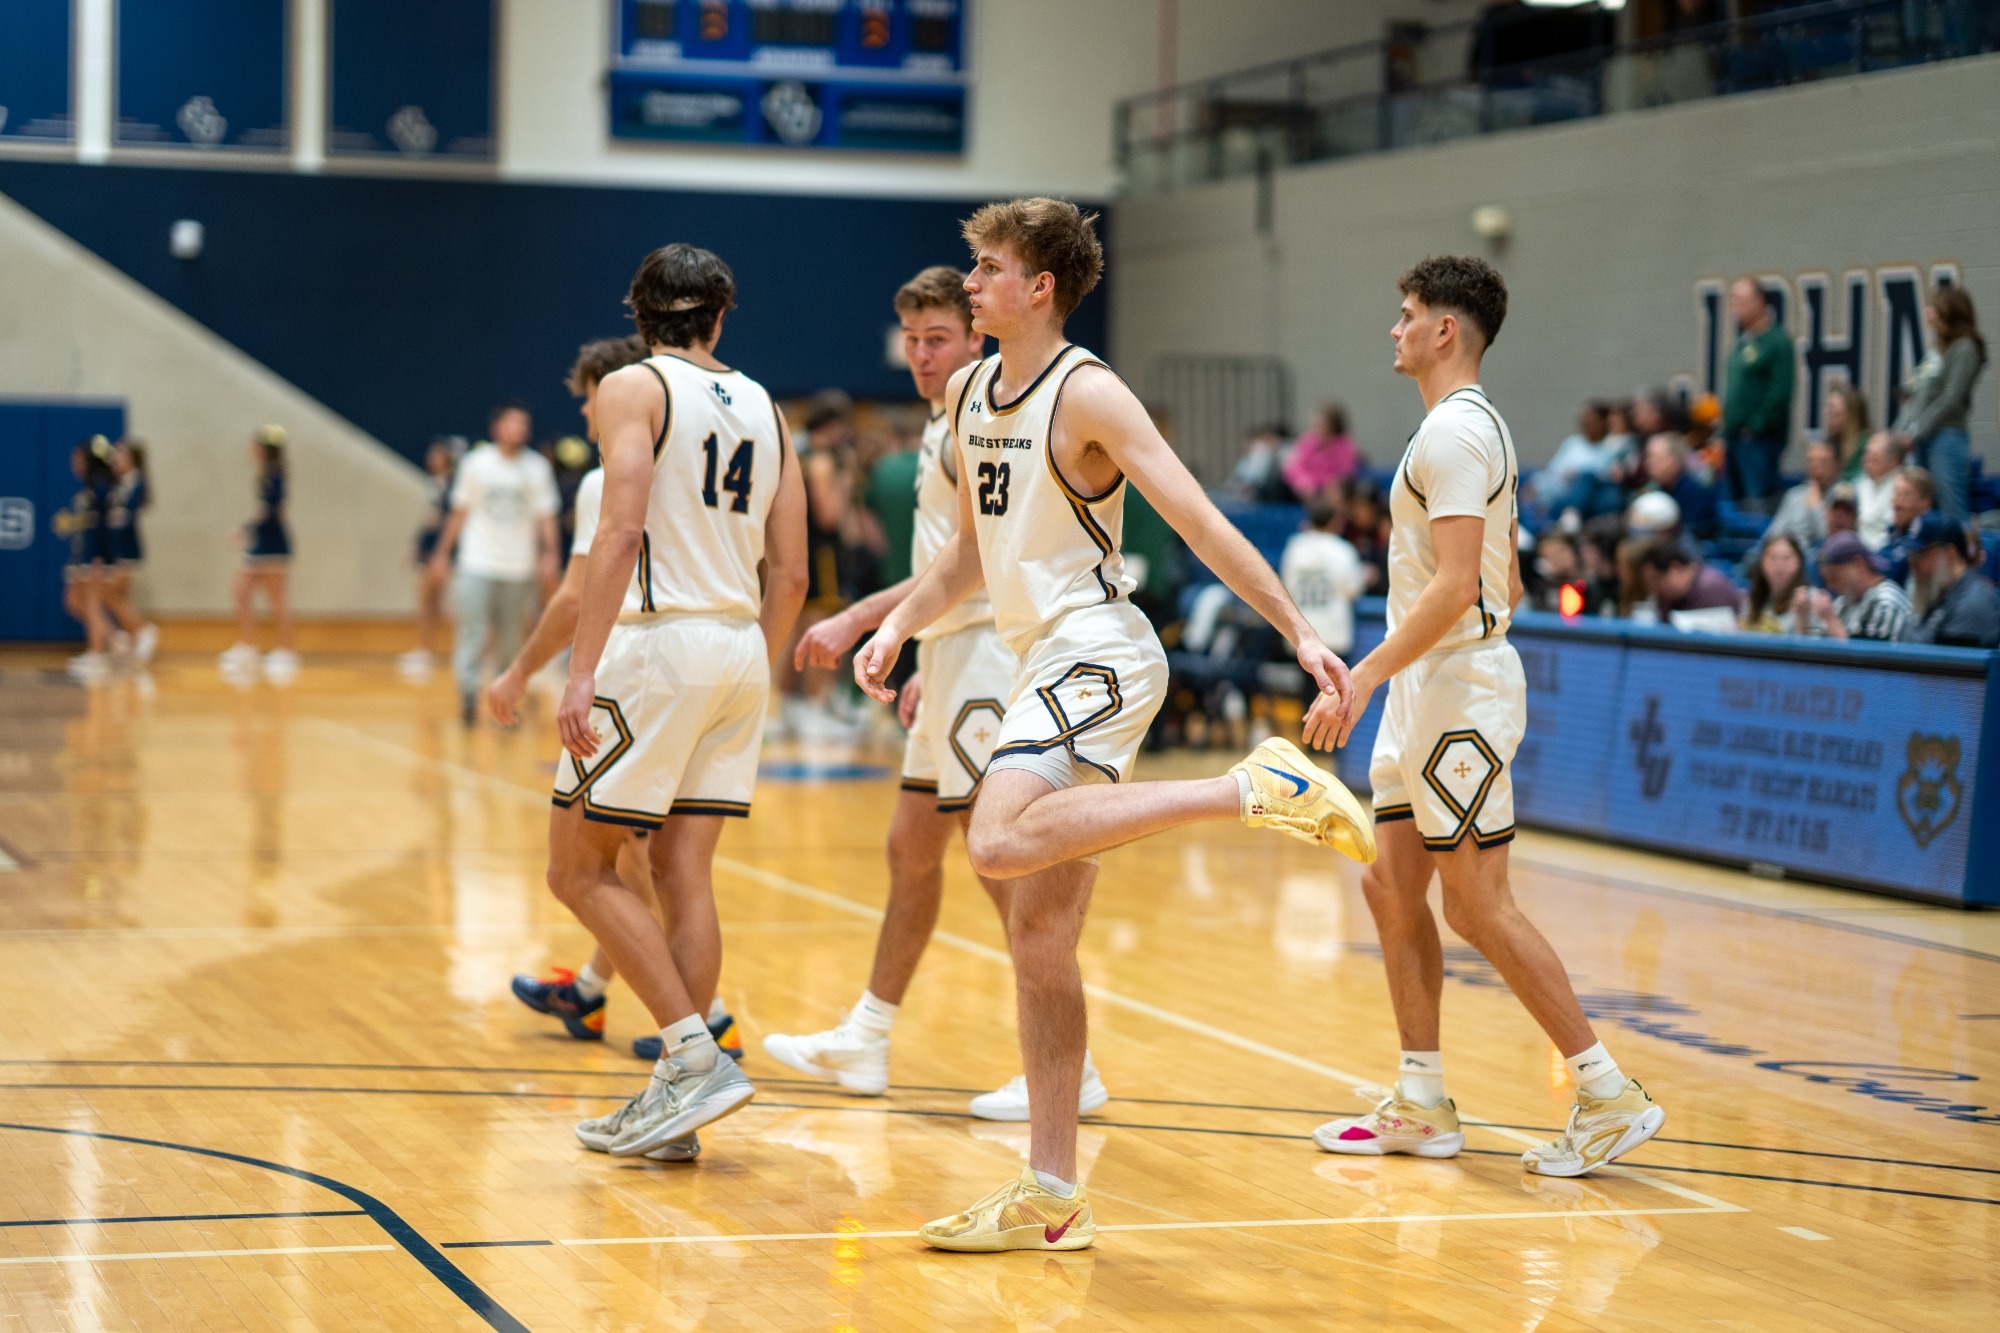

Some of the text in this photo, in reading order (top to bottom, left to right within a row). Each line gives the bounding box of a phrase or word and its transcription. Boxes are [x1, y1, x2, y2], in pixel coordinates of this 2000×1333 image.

[968, 434, 1032, 450] BLUE STREAKS
[702, 431, 755, 516] 14
[977, 460, 1011, 517] 23
